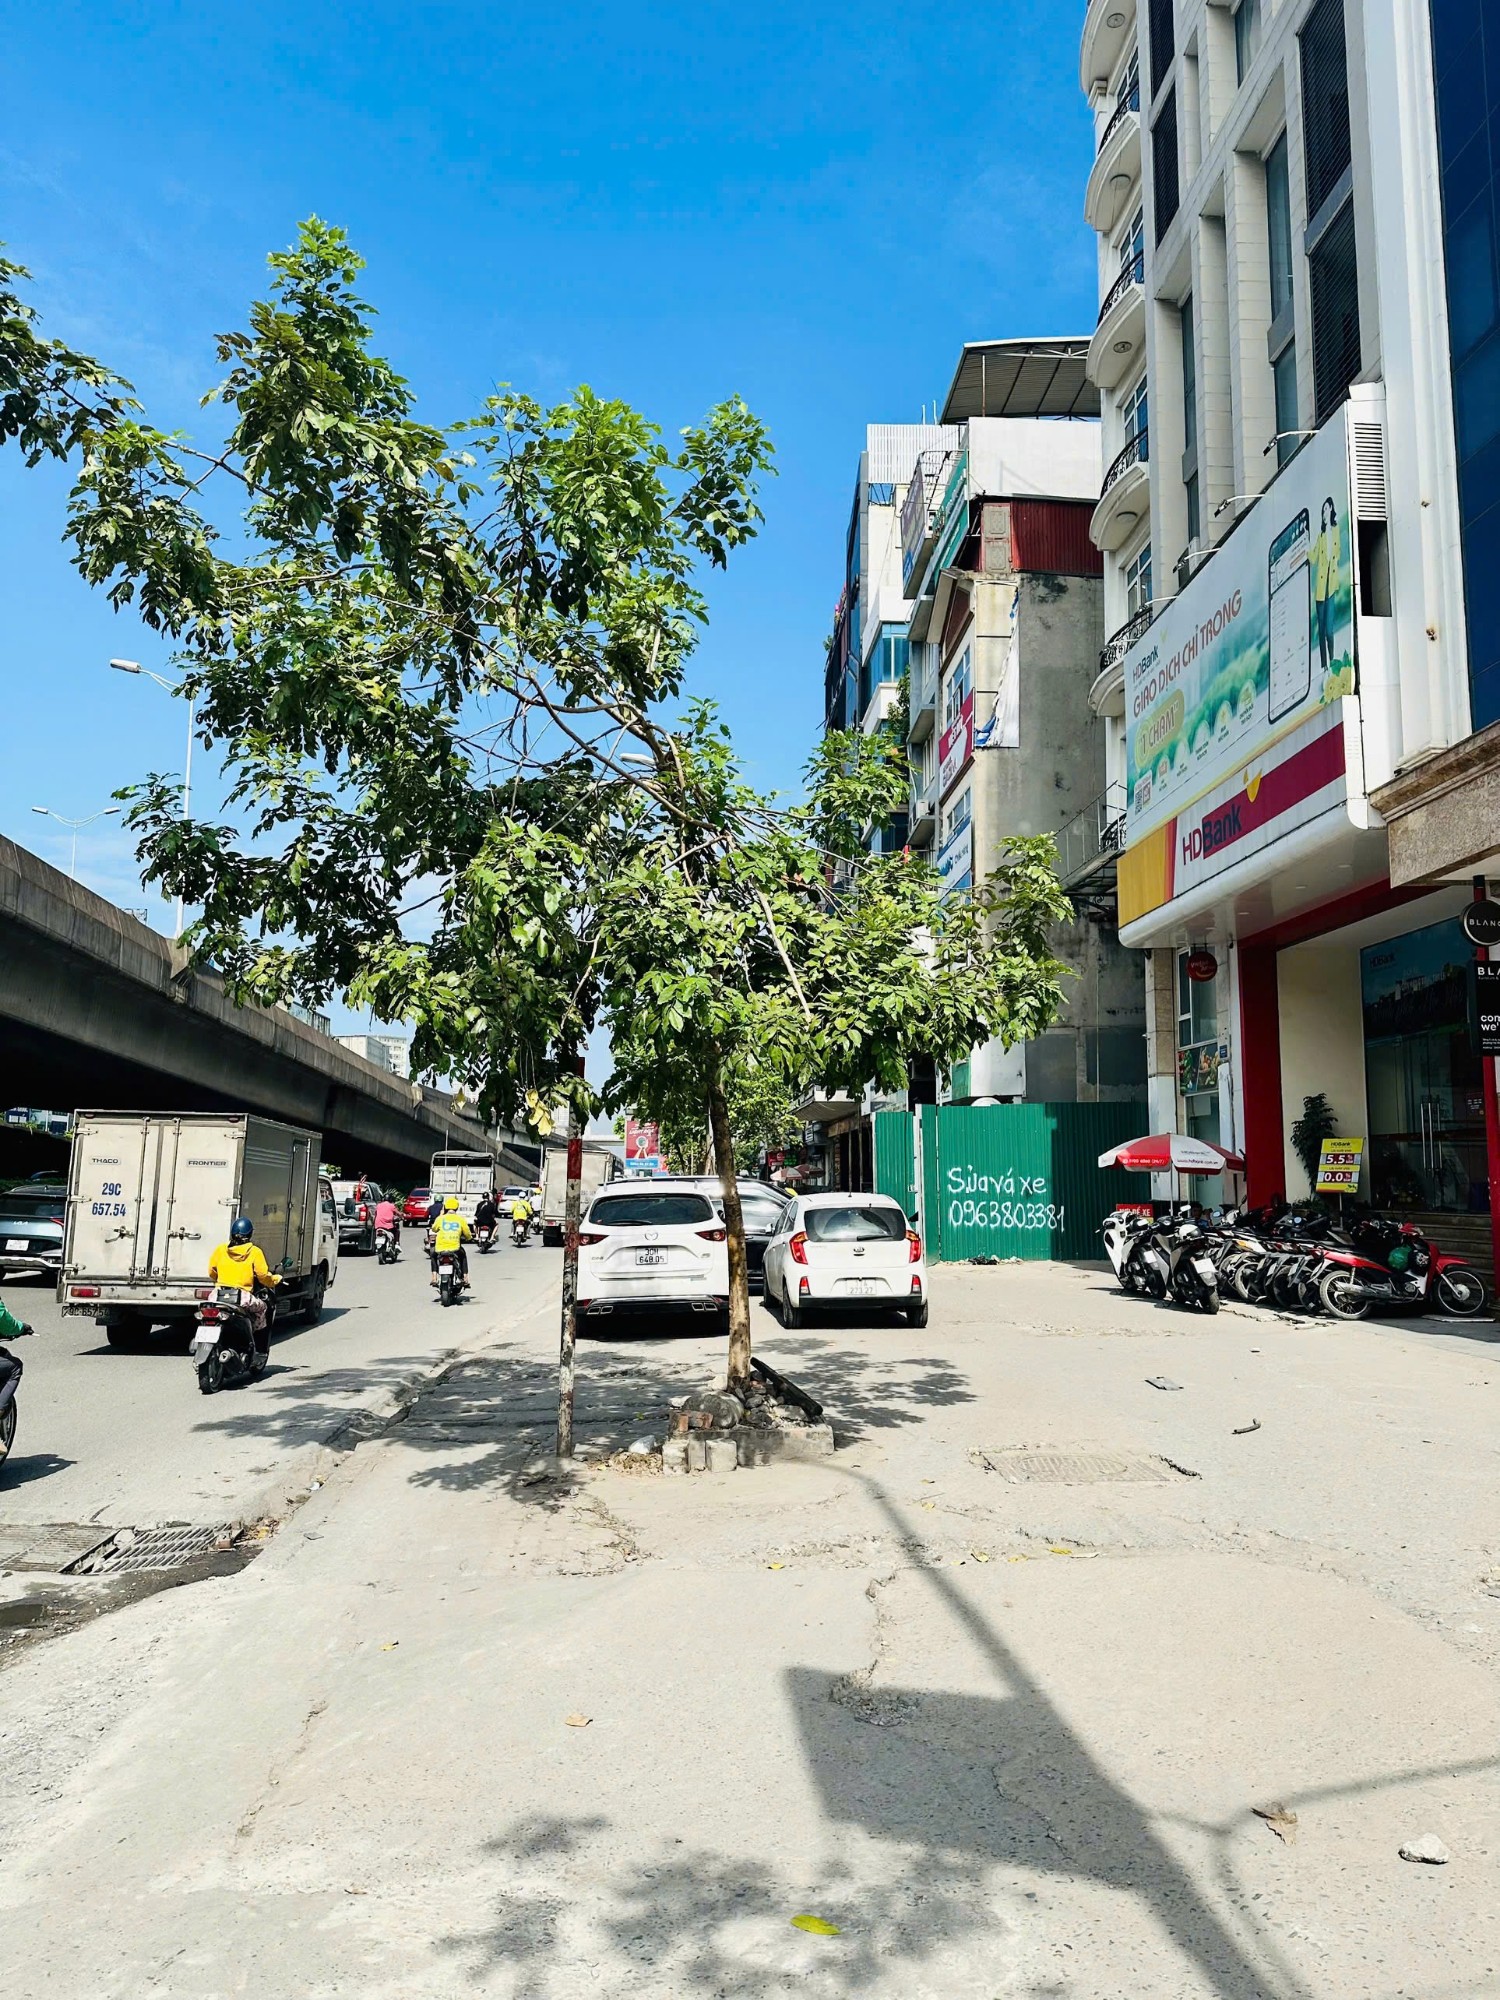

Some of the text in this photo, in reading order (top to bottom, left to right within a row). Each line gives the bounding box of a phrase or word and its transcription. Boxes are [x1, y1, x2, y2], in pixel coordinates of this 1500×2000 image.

[1159, 651, 1181, 693] DỊCH
[1182, 623, 1199, 668] CHỈ
[1200, 589, 1242, 650] TRONG
[1132, 644, 1159, 684] HDBank
[1182, 803, 1242, 866] HDBank
[1326, 1154, 1346, 1164] 5.5
[1324, 1172, 1344, 1182] 0.0
[101, 1182, 122, 1196] 29C
[1018, 1176, 1047, 1196] xe
[91, 1202, 127, 1217] 657.54
[948, 1199, 1065, 1233] 0963803381
[1142, 1208, 1151, 1217] XE
[442, 1218, 460, 1232] be
